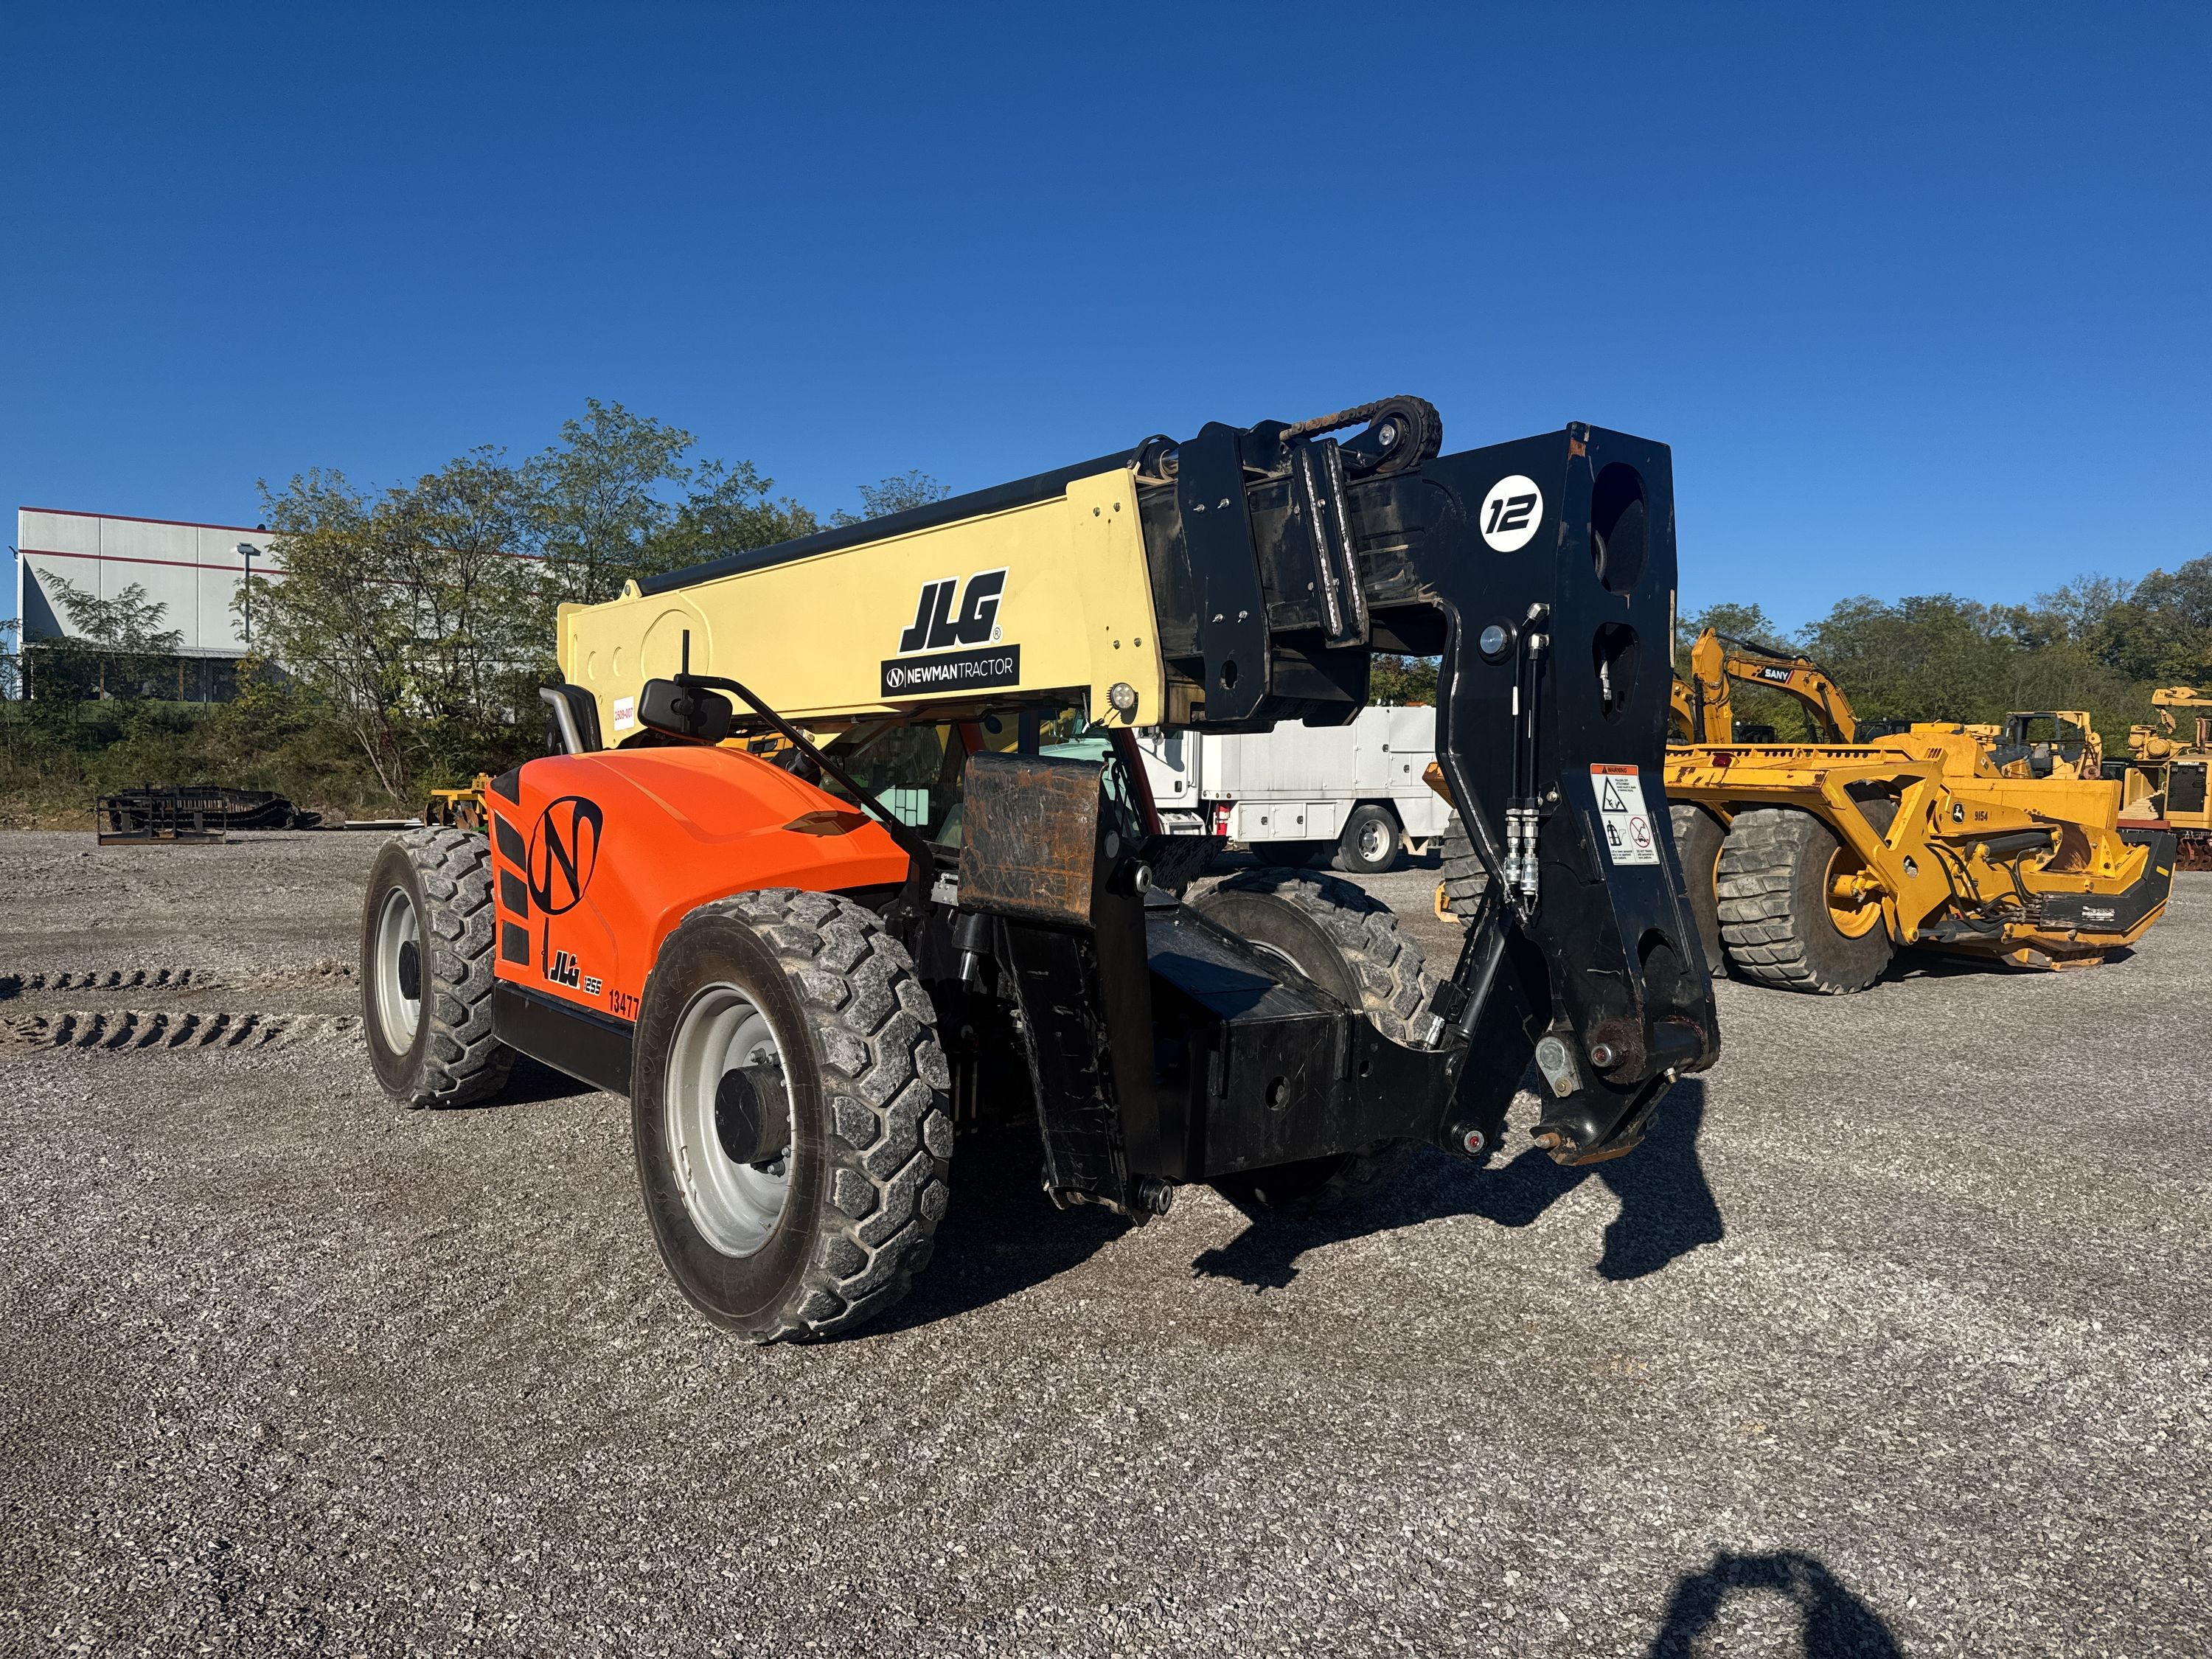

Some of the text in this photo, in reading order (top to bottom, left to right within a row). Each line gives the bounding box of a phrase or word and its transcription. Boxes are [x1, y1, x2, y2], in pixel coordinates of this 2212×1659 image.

[1485, 493, 1537, 535] 12
[899, 569, 1007, 653] JLG
[1764, 668, 1789, 681] SANY
[1975, 811, 1988, 821] 9154
[609, 989, 639, 1020] 13477
